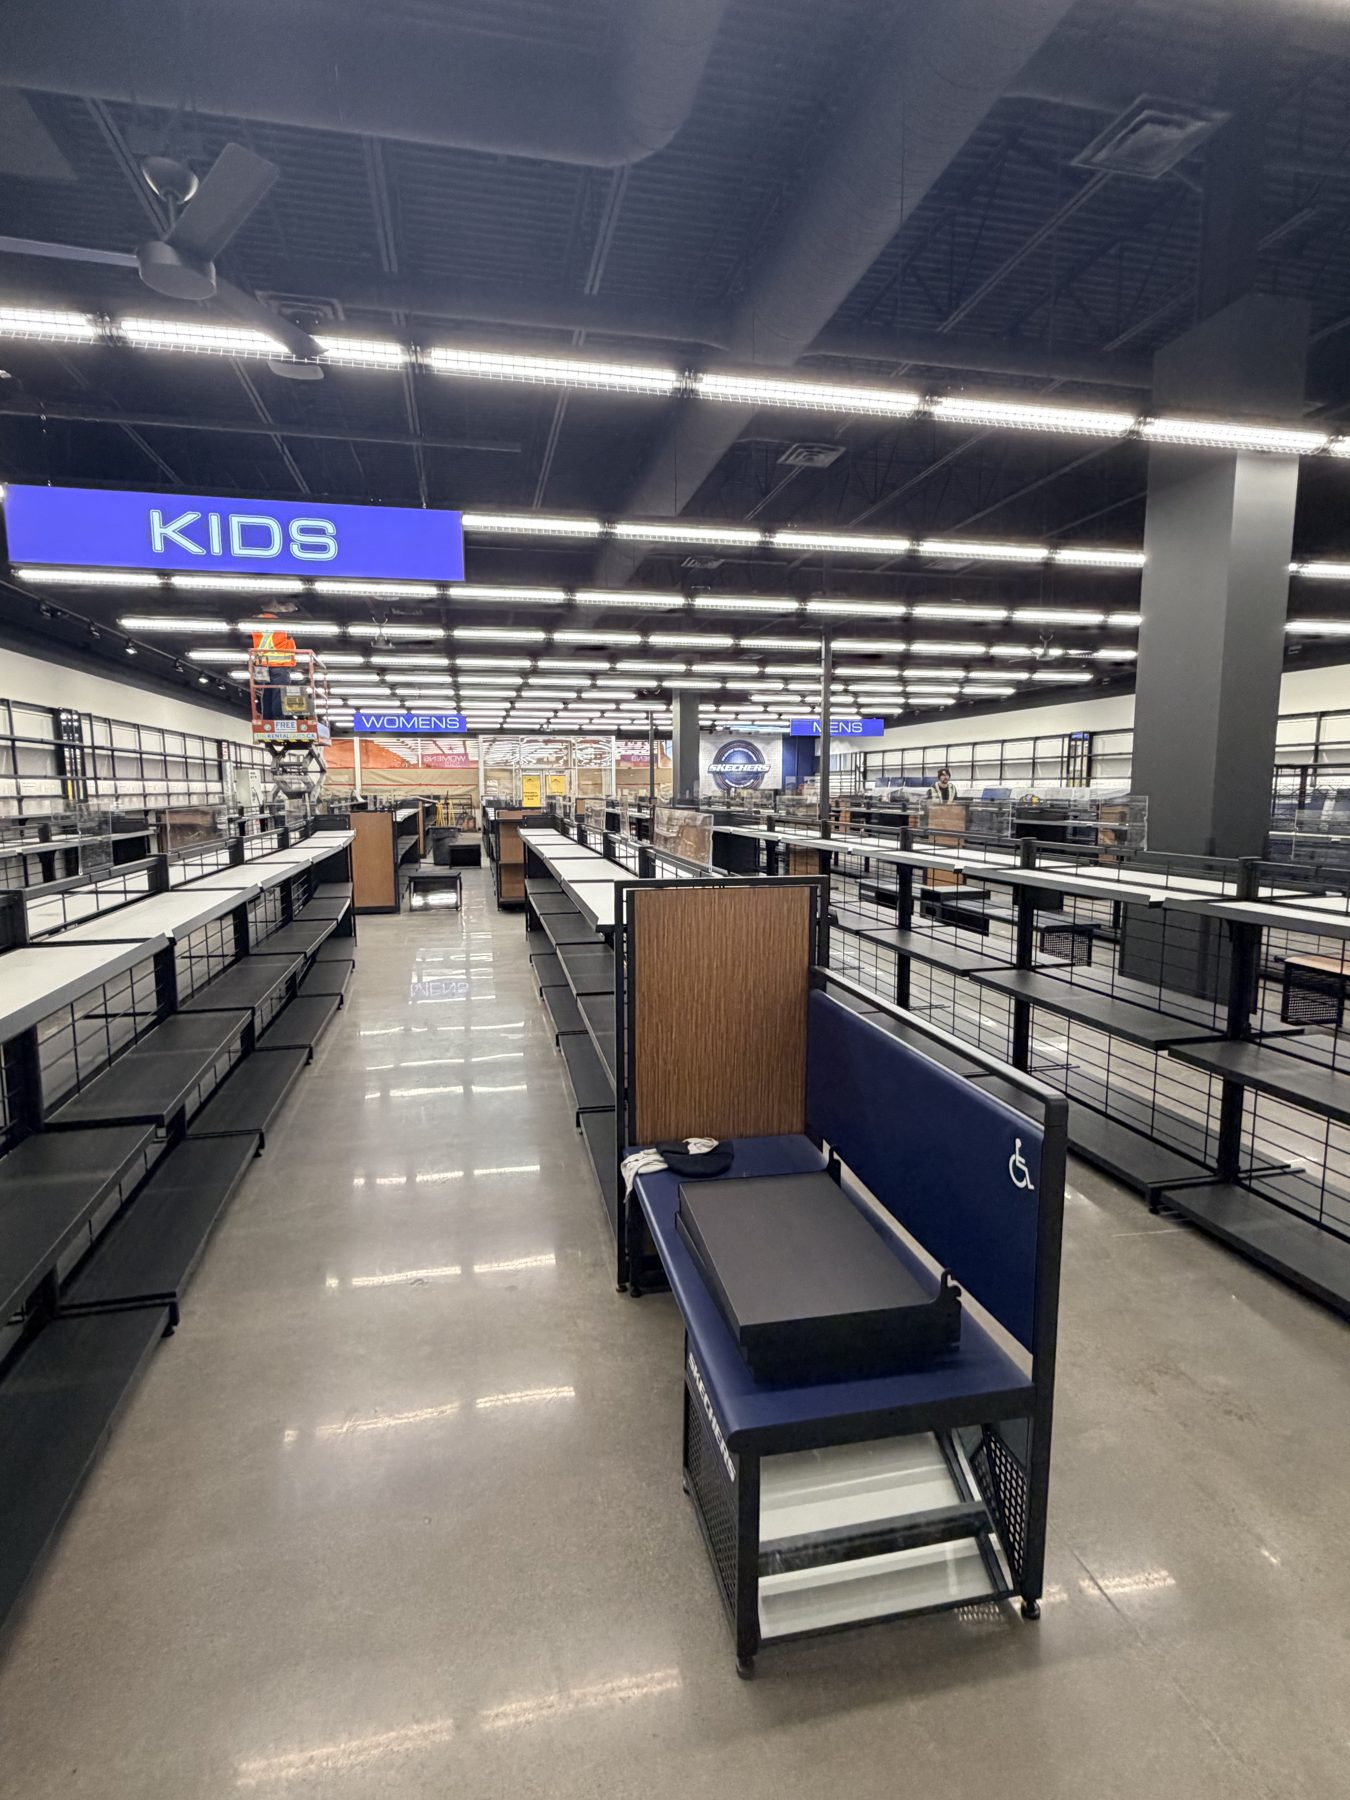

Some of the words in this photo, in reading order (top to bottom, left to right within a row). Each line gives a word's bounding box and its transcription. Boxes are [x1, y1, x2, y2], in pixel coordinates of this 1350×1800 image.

[150, 509, 338, 561] KIDS
[275, 721, 296, 729] FREE
[361, 716, 460, 729] WOMENS
[813, 721, 863, 733] MENS
[708, 763, 771, 772] SKECHERS
[688, 1352, 736, 1483] SKECHERS
